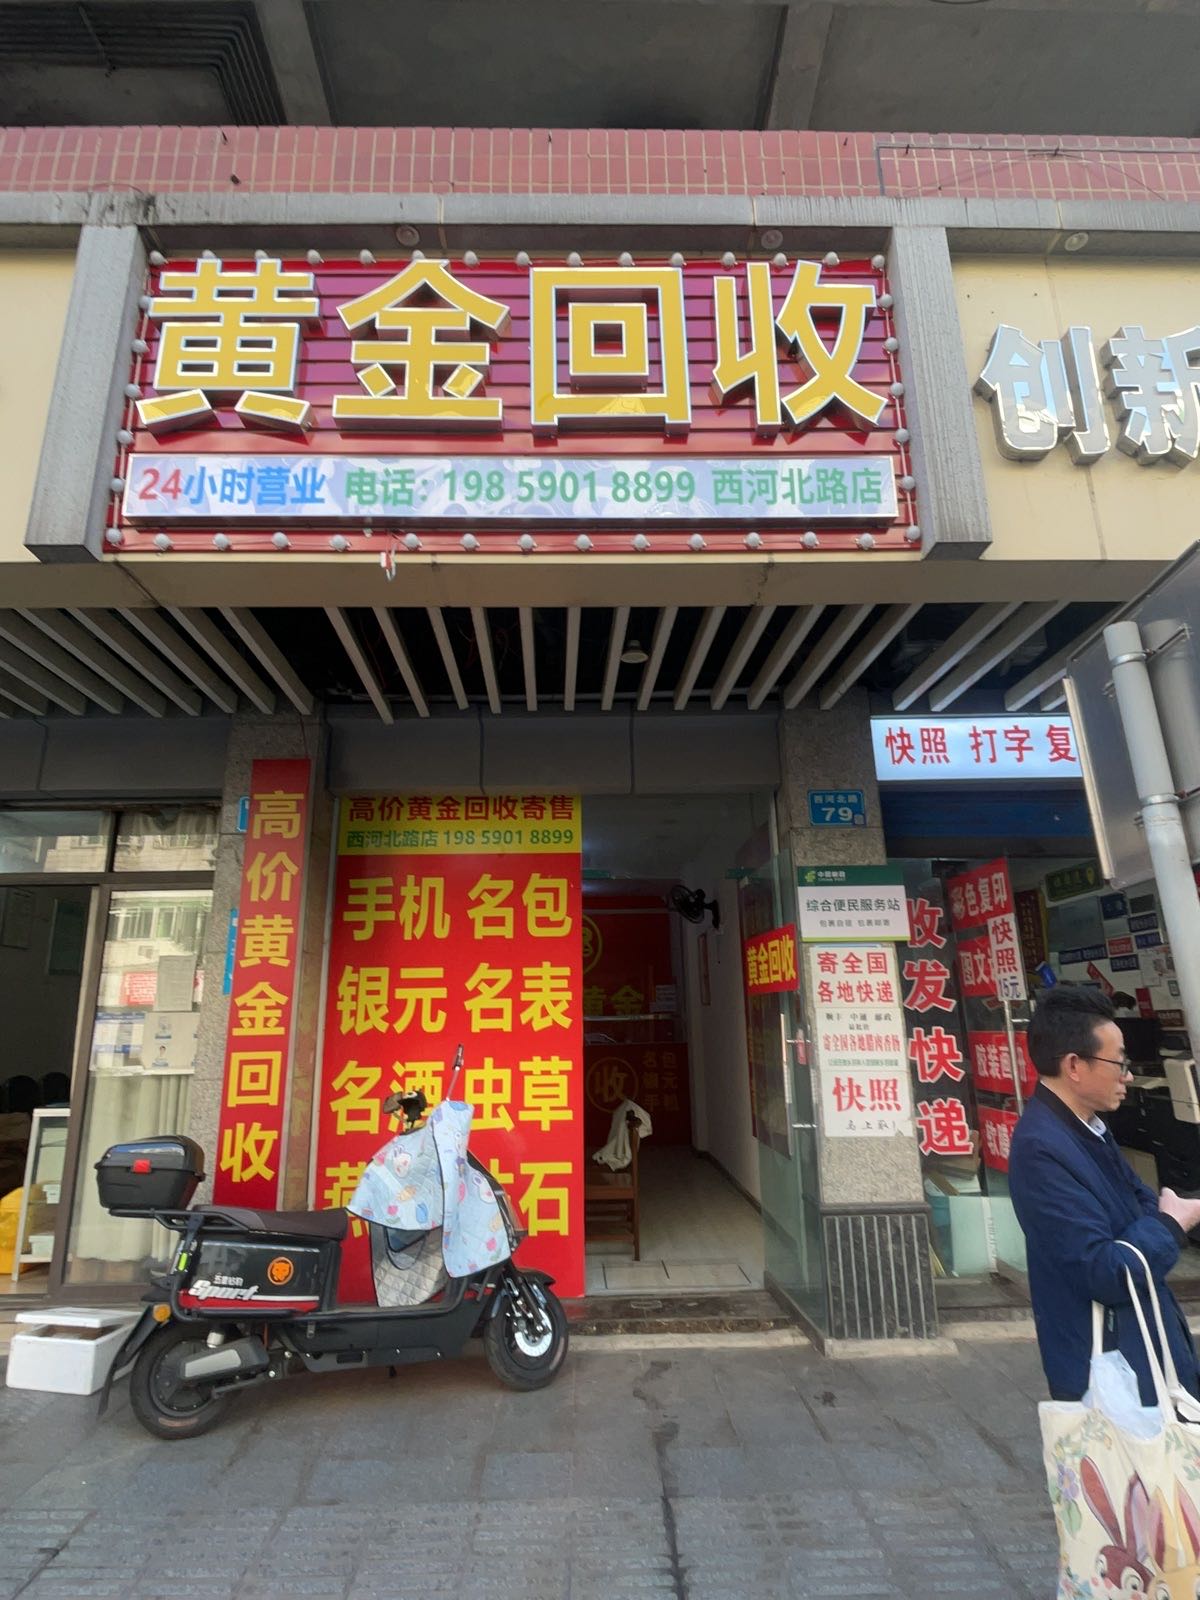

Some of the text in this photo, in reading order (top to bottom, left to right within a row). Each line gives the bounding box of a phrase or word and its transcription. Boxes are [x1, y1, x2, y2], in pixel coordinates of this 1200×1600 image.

[135, 258, 888, 427] 黄金回收
[138, 467, 327, 506] 24小时营业
[517, 470, 597, 502] 5901
[611, 470, 696, 502] 8899
[711, 467, 882, 505] 西河北路店
[885, 726, 950, 765] 快照
[969, 725, 1034, 764] 打字
[349, 795, 575, 822] 高价黄金回收寄售
[821, 807, 853, 822] 79
[346, 828, 574, 849] 西河北路店 198 5901 8899
[343, 873, 573, 942] 手机 名包
[806, 898, 901, 912] 综合便民服务站
[951, 872, 1008, 920] 彩色复印
[747, 934, 797, 986] 黄金回收
[817, 952, 889, 975] 寄全国
[992, 919, 1018, 974] 快照
[219, 790, 304, 1183] 高价黄金回收
[959, 948, 996, 986] 图文
[336, 961, 573, 1036] 银元 名表
[817, 980, 895, 1004] 各地快递
[902, 898, 974, 1156] 收发快递
[464, 1056, 573, 1132] 虫草
[832, 1076, 902, 1113] 快照
[188, 1280, 259, 1300] Sport
